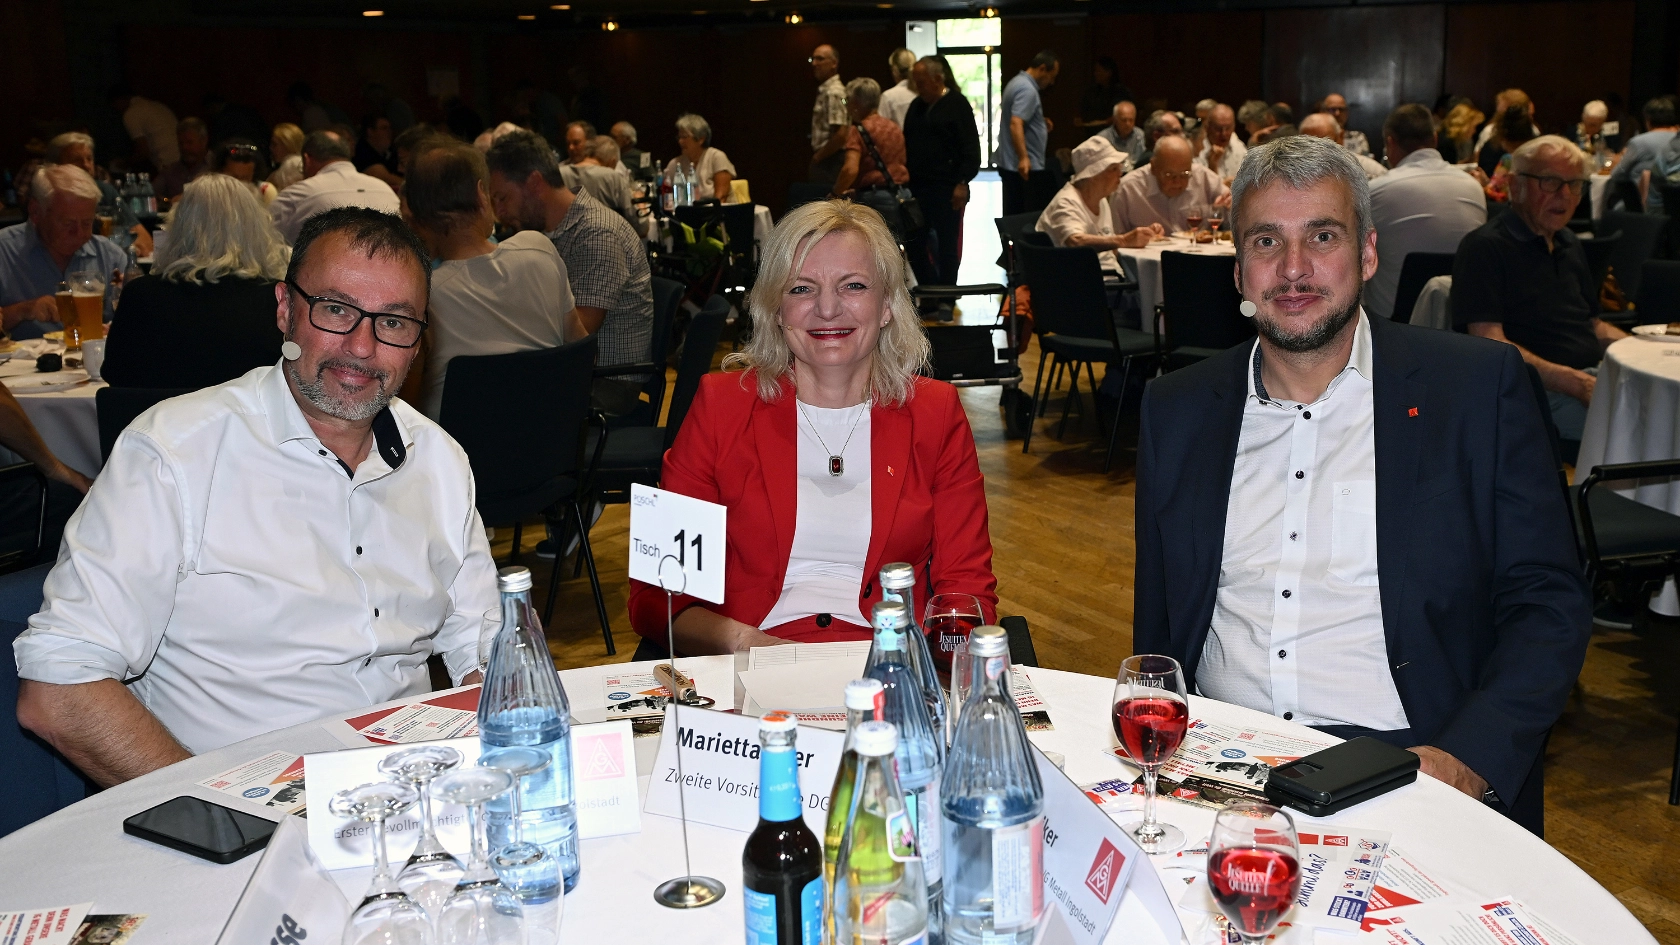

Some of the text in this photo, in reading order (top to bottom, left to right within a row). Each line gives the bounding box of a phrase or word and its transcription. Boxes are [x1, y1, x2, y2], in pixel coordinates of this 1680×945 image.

[633, 529, 703, 572] Tisch 11
[676, 726, 815, 769] Marietta er
[665, 768, 712, 790] Zweite
[808, 793, 831, 812] DG
[333, 826, 370, 839] Erster
[574, 796, 621, 810] olstadt
[1043, 815, 1059, 848] ker
[1048, 877, 1068, 902] Metall
[1064, 894, 1097, 936] Ingolstadt
